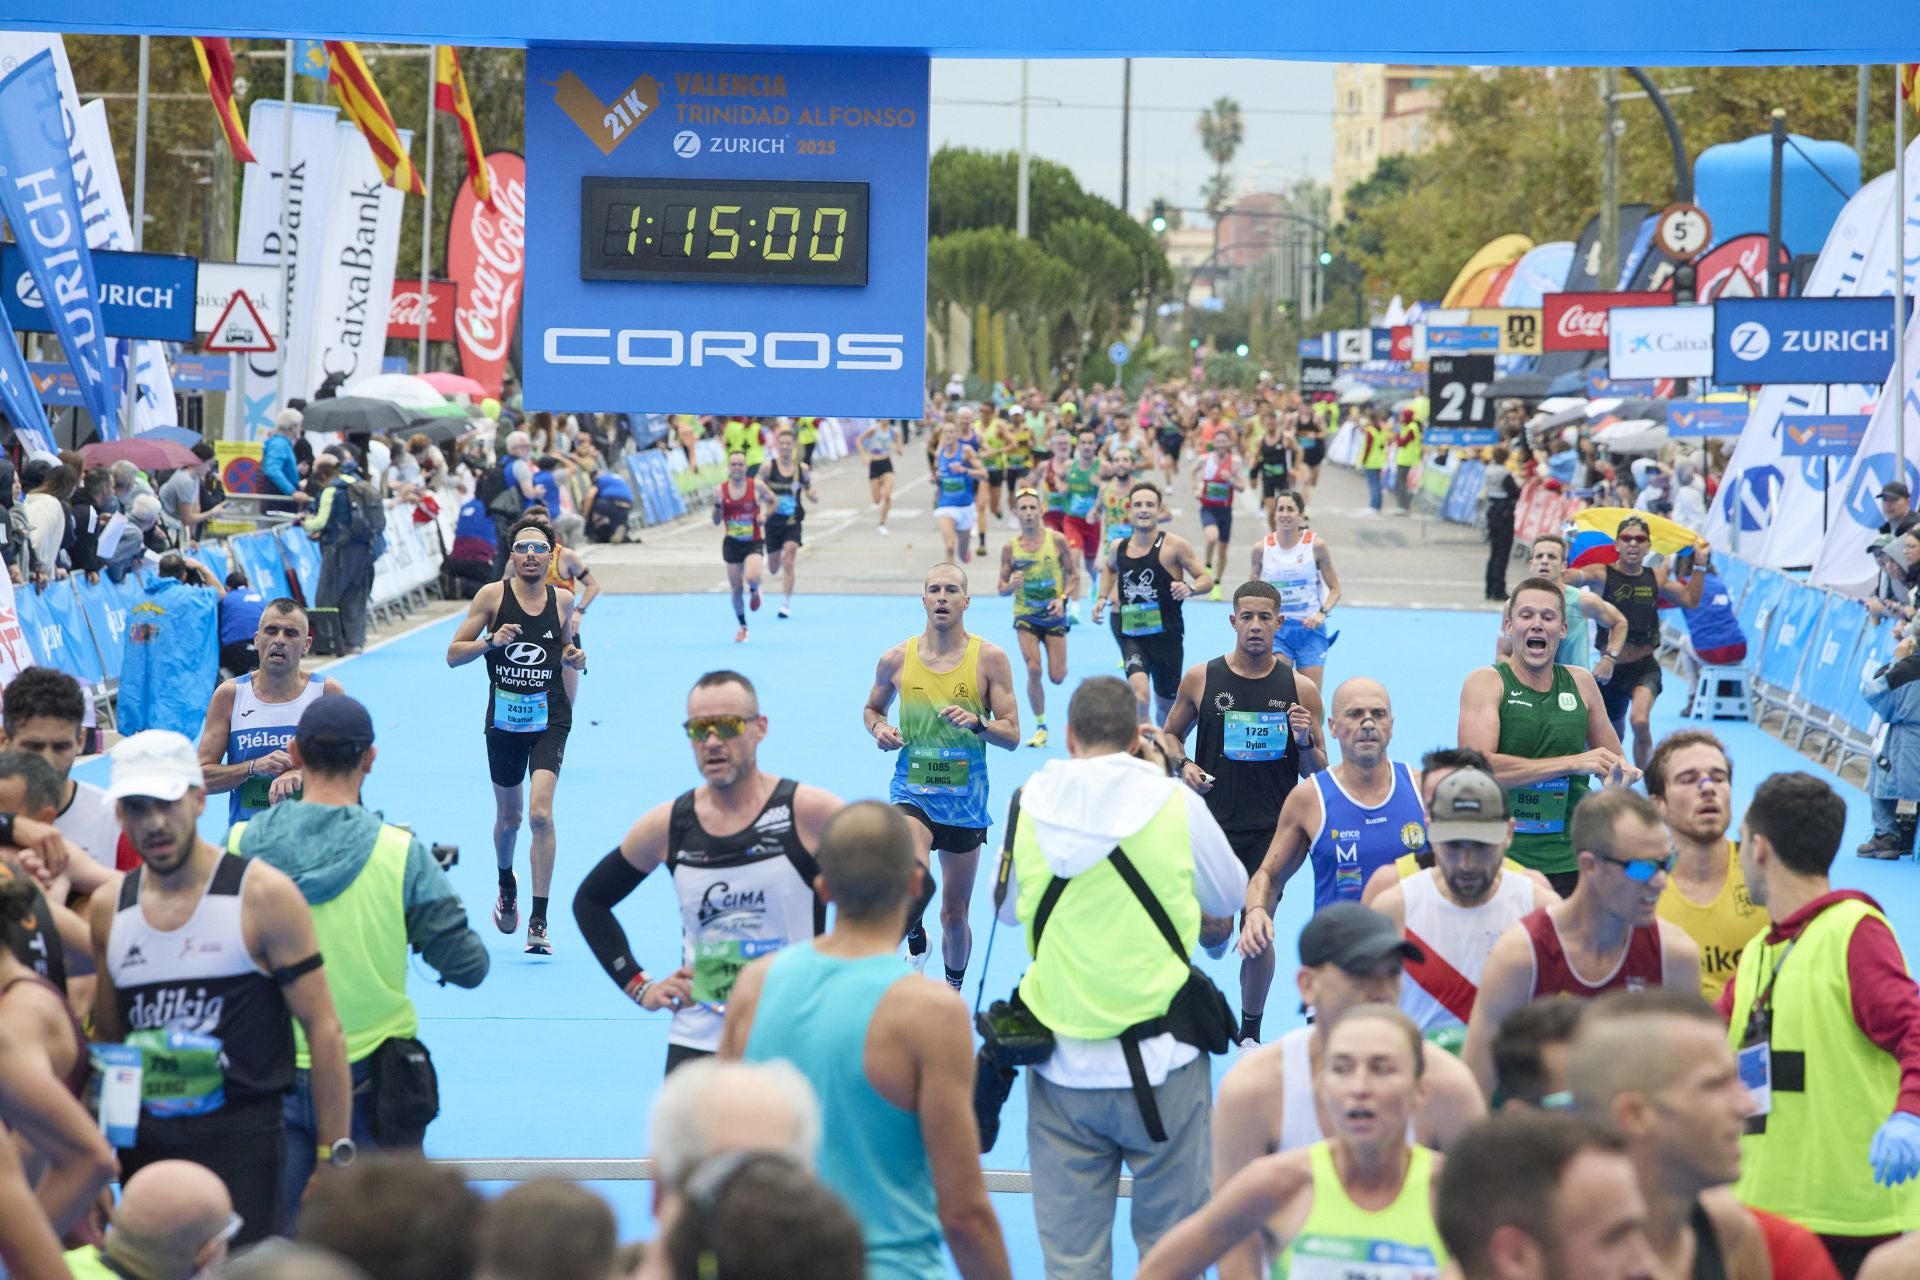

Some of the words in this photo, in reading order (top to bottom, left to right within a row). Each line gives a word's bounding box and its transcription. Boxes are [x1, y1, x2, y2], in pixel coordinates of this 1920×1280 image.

[675, 72, 787, 97] VALENCIA
[603, 88, 649, 141] 21K
[675, 104, 790, 125] TRINIDAD
[797, 105, 916, 128] ALFONSO
[709, 137, 785, 154] ZURICH
[796, 139, 837, 155] 2025
[627, 205, 848, 262] 1:15:00
[322, 181, 382, 380] CaixaBank
[98, 284, 173, 310] URICH
[543, 327, 904, 371] COROS
[1656, 333, 1710, 352] Caixa
[1781, 329, 1889, 352] ZURICH
[1436, 381, 1488, 422] 21
[495, 664, 553, 680] HYUNDAI
[501, 676, 527, 687] Koryo
[528, 678, 545, 687] Car
[507, 704, 533, 713] 24313
[237, 731, 297, 751] Piélag
[1245, 727, 1269, 737] 1725
[1246, 740, 1267, 750] Dylan
[927, 762, 950, 772] 1085
[1517, 794, 1540, 805] 896
[1514, 809, 1541, 821] Georg
